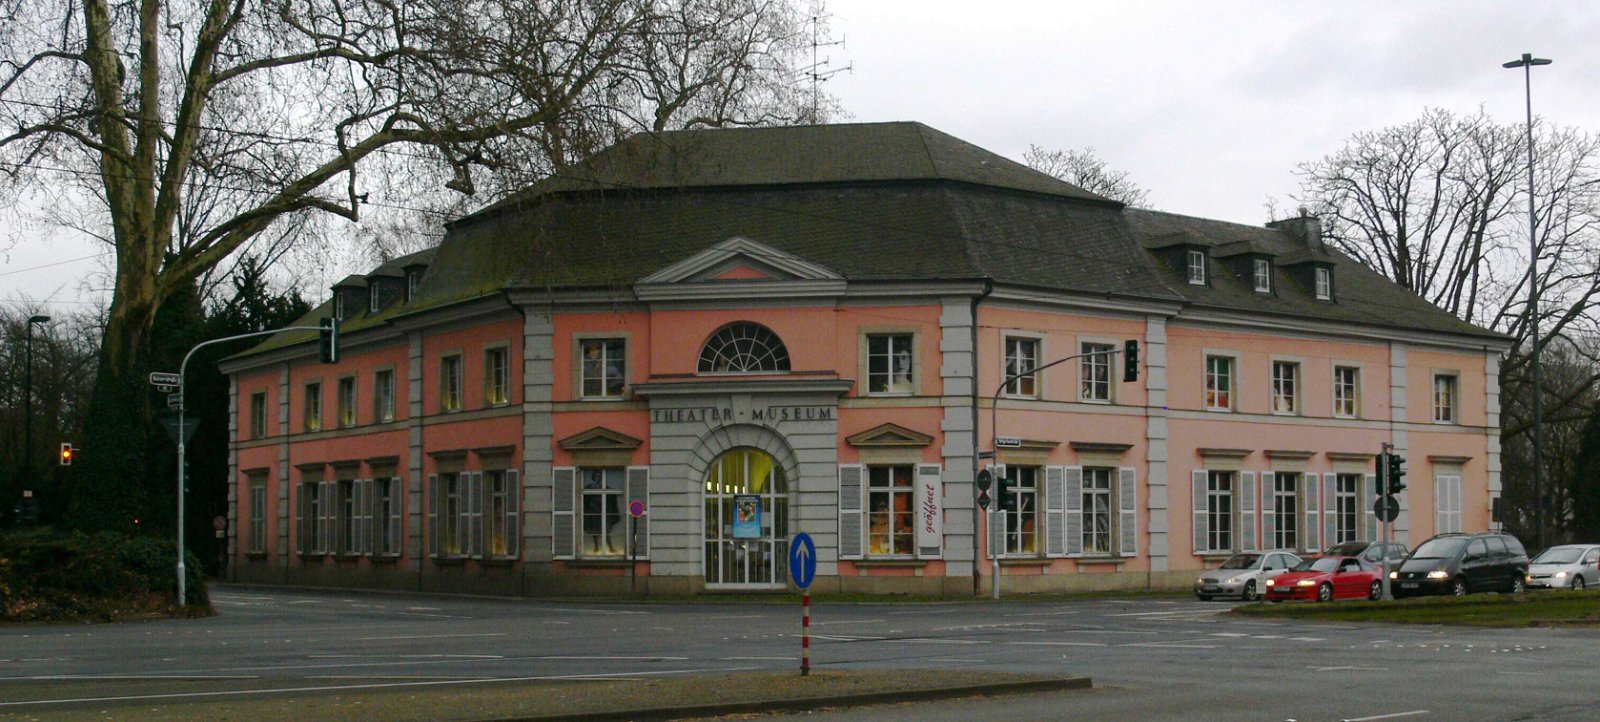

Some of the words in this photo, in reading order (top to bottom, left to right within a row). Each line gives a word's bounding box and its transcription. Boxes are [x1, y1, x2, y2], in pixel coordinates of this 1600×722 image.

[653, 409, 732, 422] THEATER
[751, 407, 832, 421] MUSEUM
[923, 484, 937, 533] geöffnet
